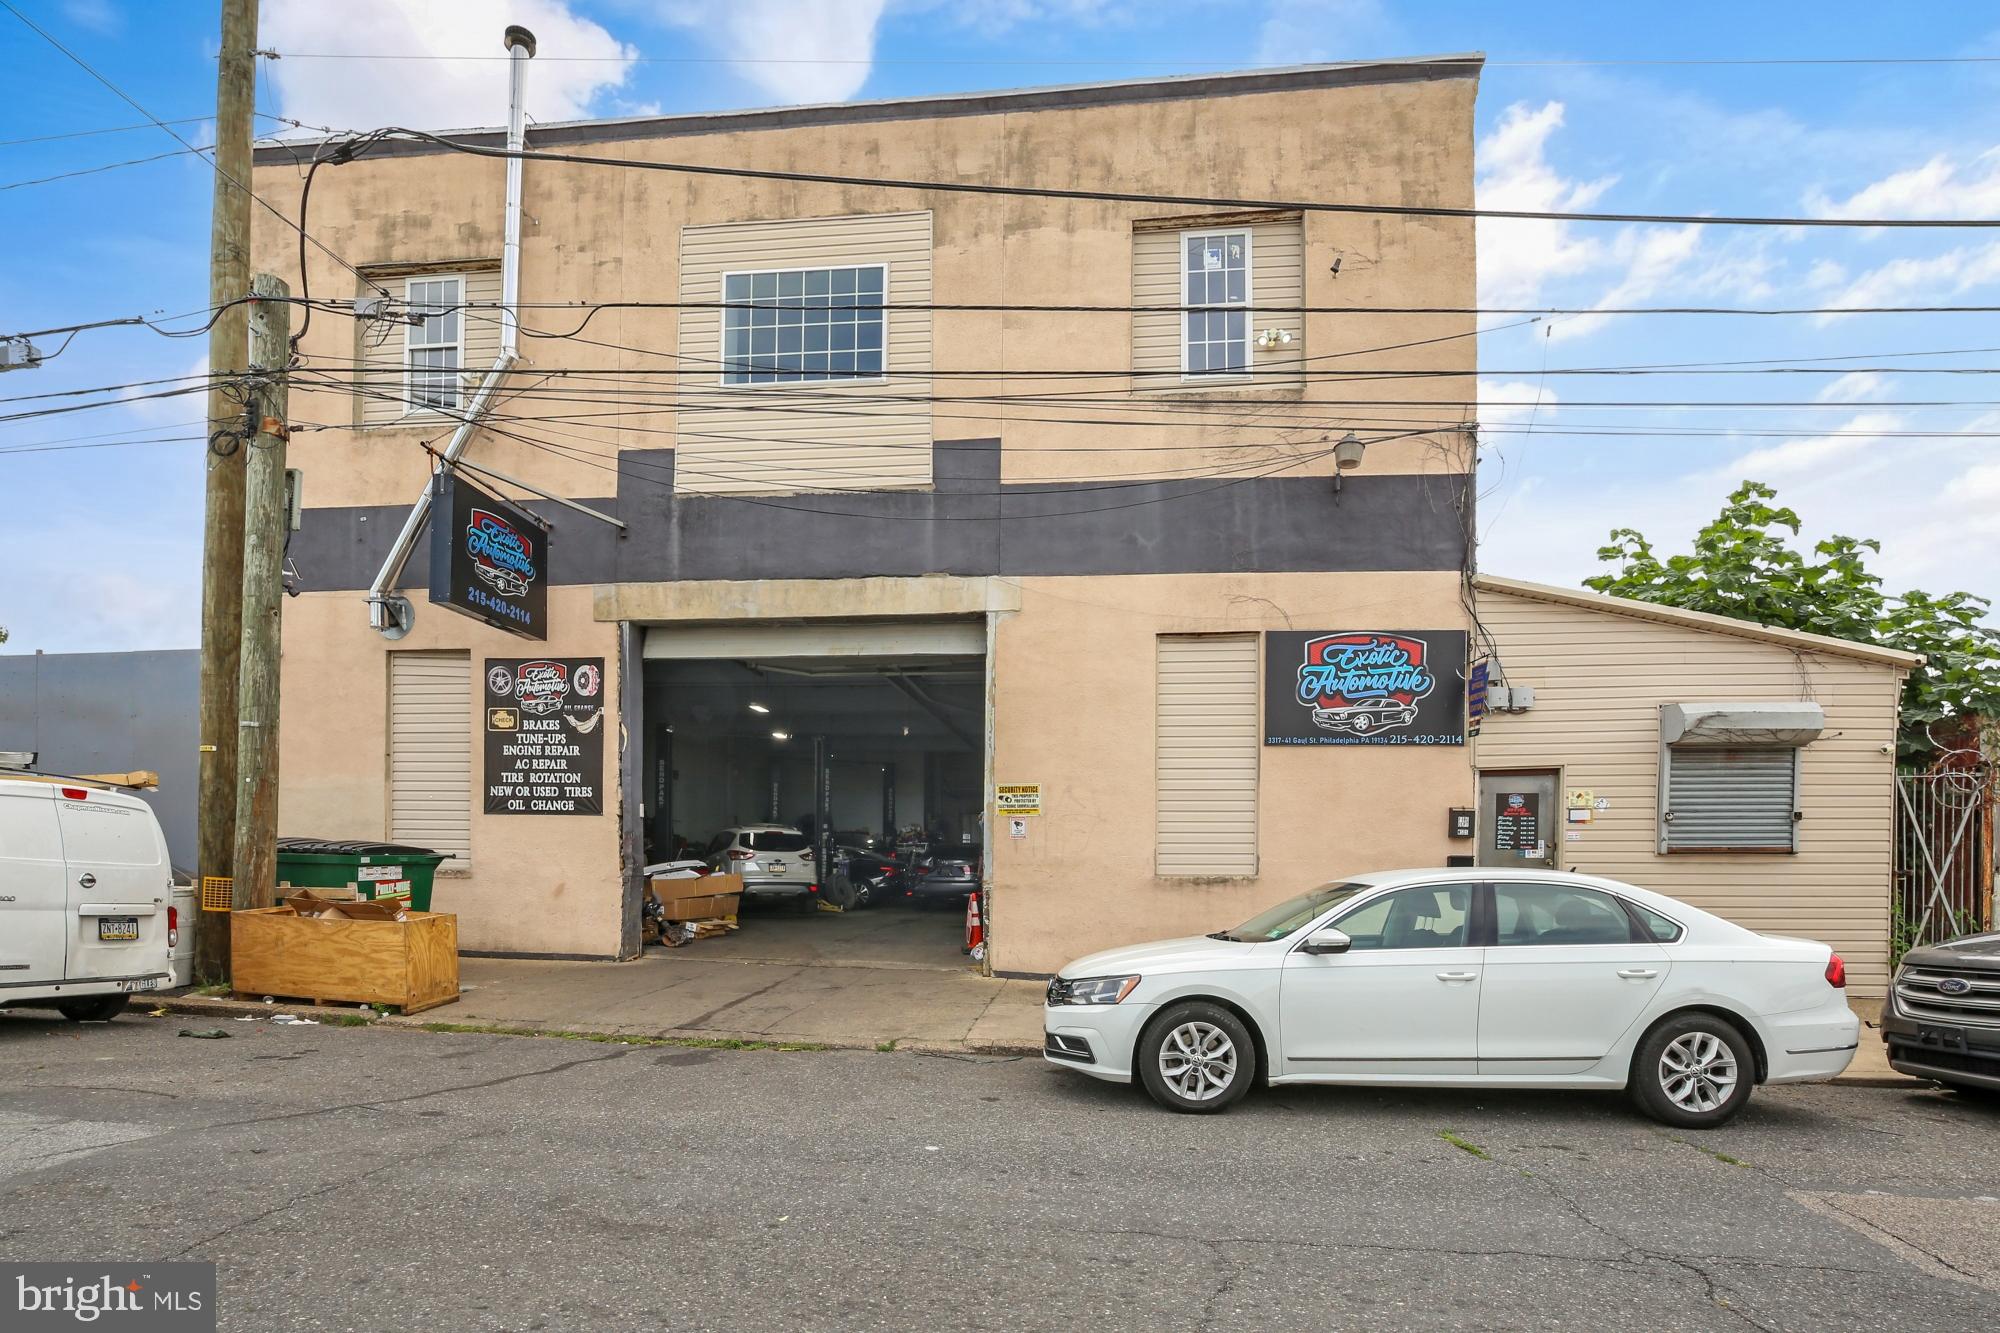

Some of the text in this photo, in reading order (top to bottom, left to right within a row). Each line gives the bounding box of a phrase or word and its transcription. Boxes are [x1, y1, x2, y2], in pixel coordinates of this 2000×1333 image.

[482, 518, 524, 551] Exotic
[468, 527, 535, 575] Automotive
[468, 586, 531, 625] 215-420-2114
[1323, 639, 1408, 670] Exotic
[525, 664, 561, 679] Exotic
[516, 678, 569, 696] Automotive
[1300, 666, 1430, 700] Automotive
[523, 720, 560, 730] BRAKES
[516, 734, 566, 744] TUNE-UPS
[1320, 737, 1359, 745] Philadelphia
[1390, 734, 1463, 744] 215-420-2114
[503, 746, 580, 756] ENGINE REPAIR
[515, 759, 568, 769] AC REPAIR
[501, 772, 581, 784] TIRE ROTATION
[490, 786, 592, 797] NEW OR USED TIRES
[508, 800, 574, 810] OIL CHANGE
[1942, 982, 1962, 992] Ford
